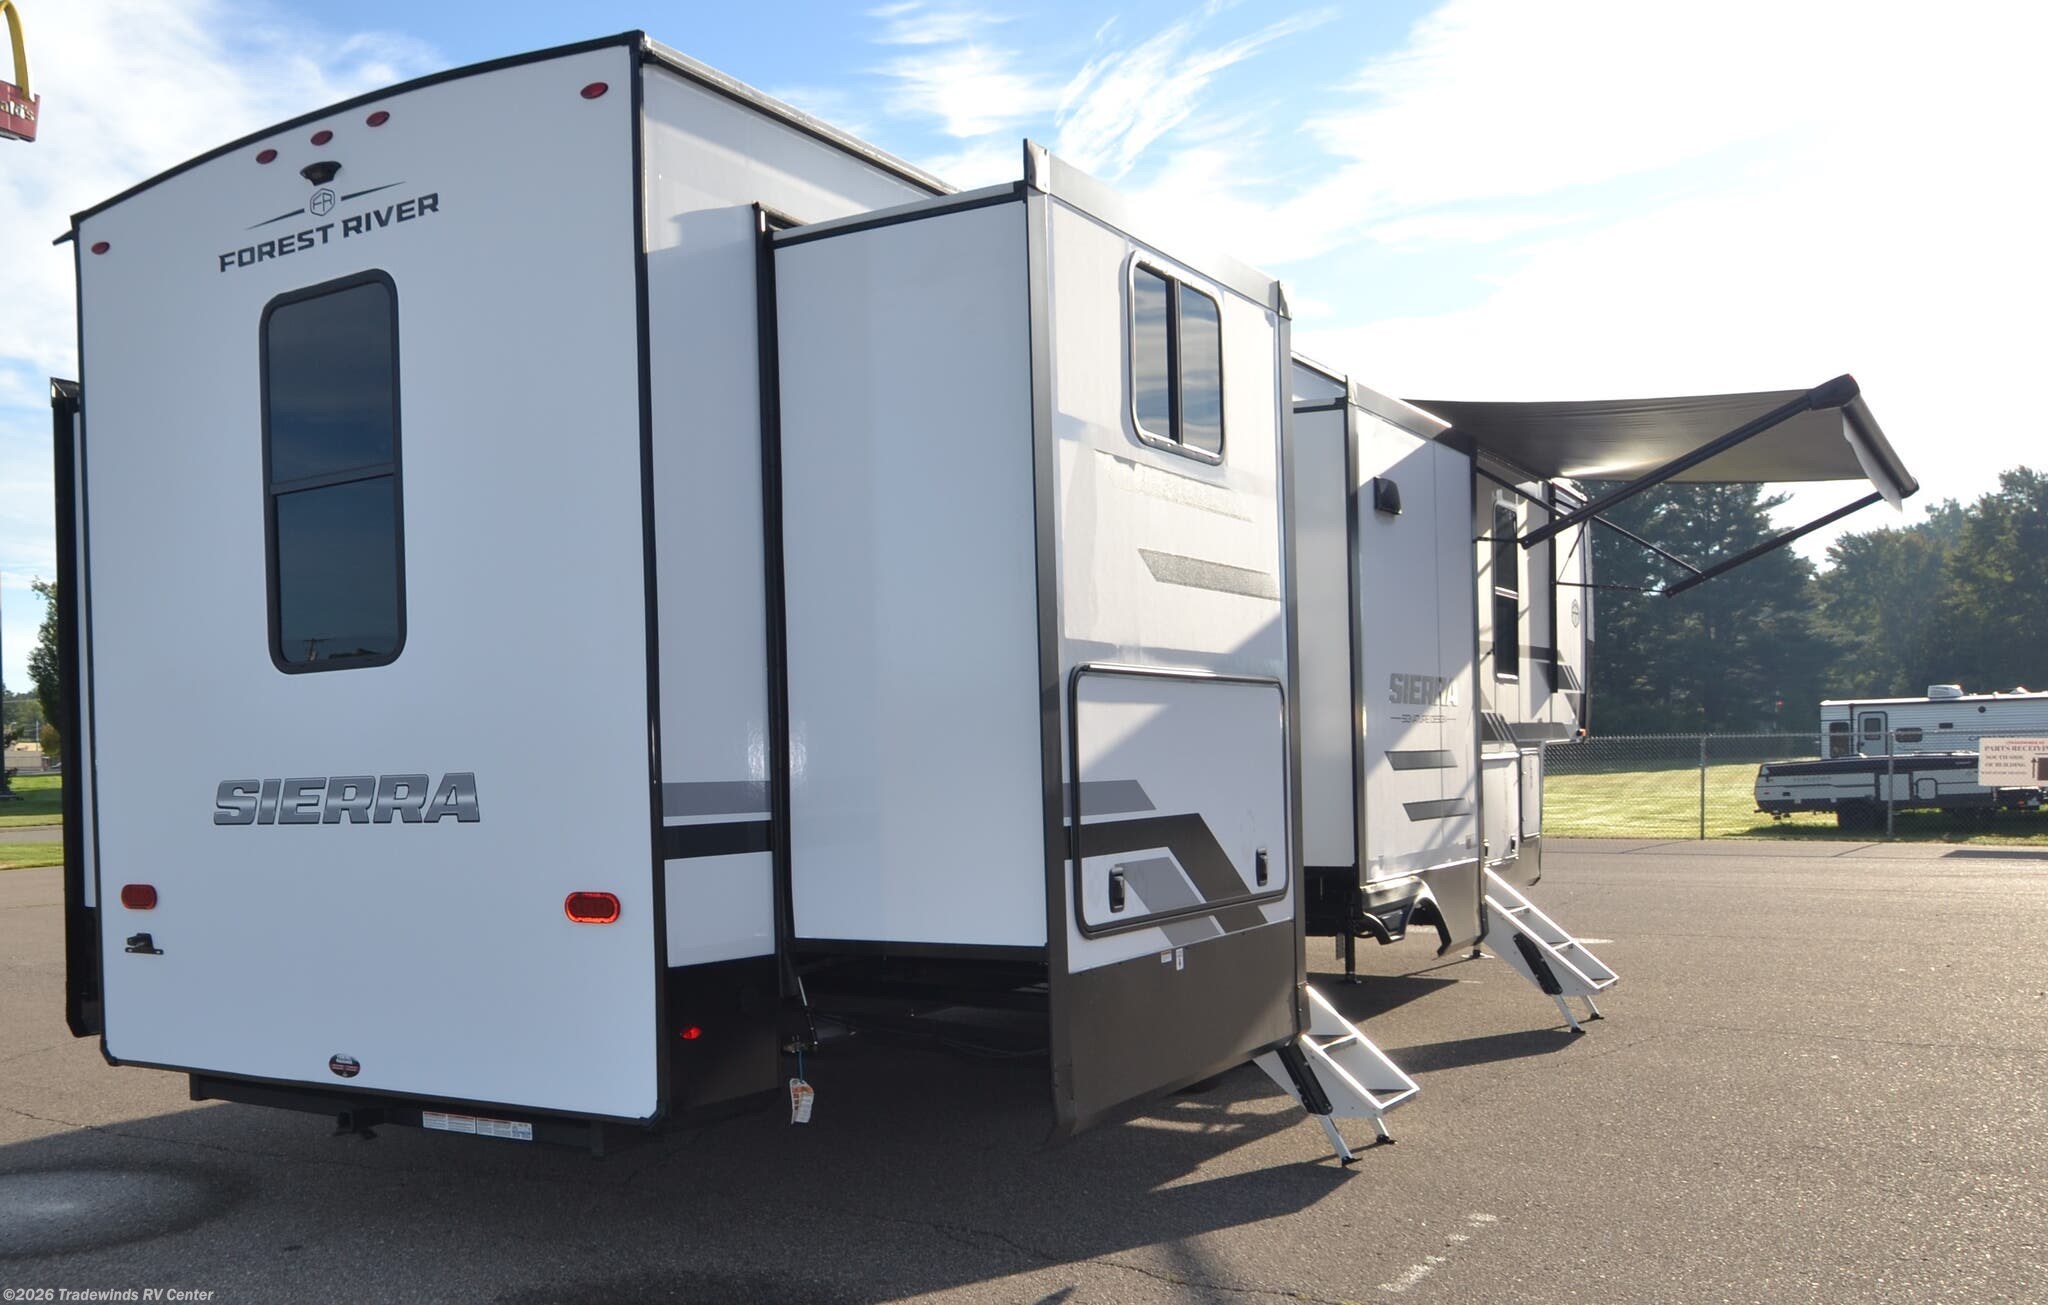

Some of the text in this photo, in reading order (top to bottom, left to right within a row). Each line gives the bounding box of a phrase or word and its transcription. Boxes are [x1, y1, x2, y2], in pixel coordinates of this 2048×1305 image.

[218, 192, 439, 273] FOREST RIVER
[1389, 673, 1458, 707] SIERRA
[213, 772, 480, 825] SIERRA
